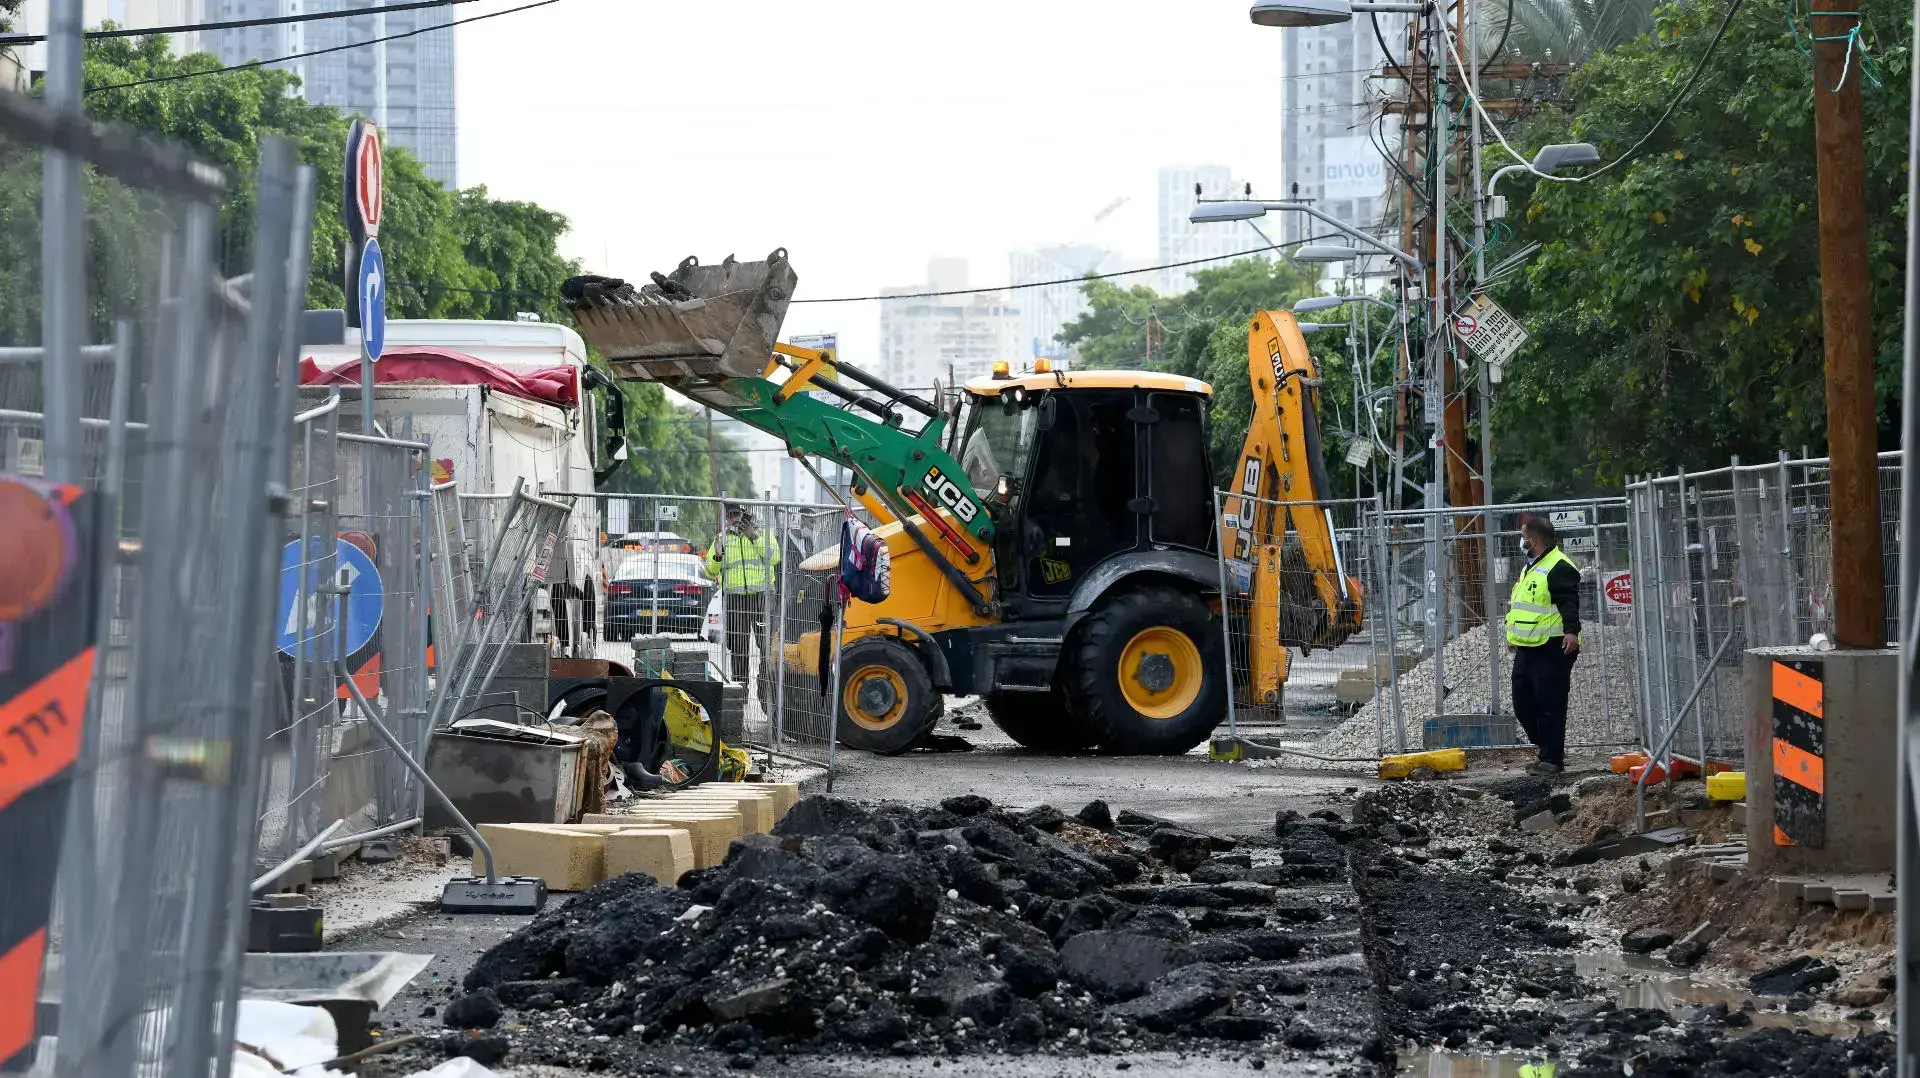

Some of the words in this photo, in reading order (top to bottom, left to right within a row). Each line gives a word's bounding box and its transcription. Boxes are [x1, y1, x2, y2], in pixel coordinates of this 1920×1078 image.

[1485, 310, 1503, 327] מתח
[1490, 316, 1509, 335] סכנת
[1480, 342, 1498, 360] Danger
[924, 473, 977, 523] JCB
[1237, 460, 1260, 558] JCB
[1045, 561, 1069, 582] JCB
